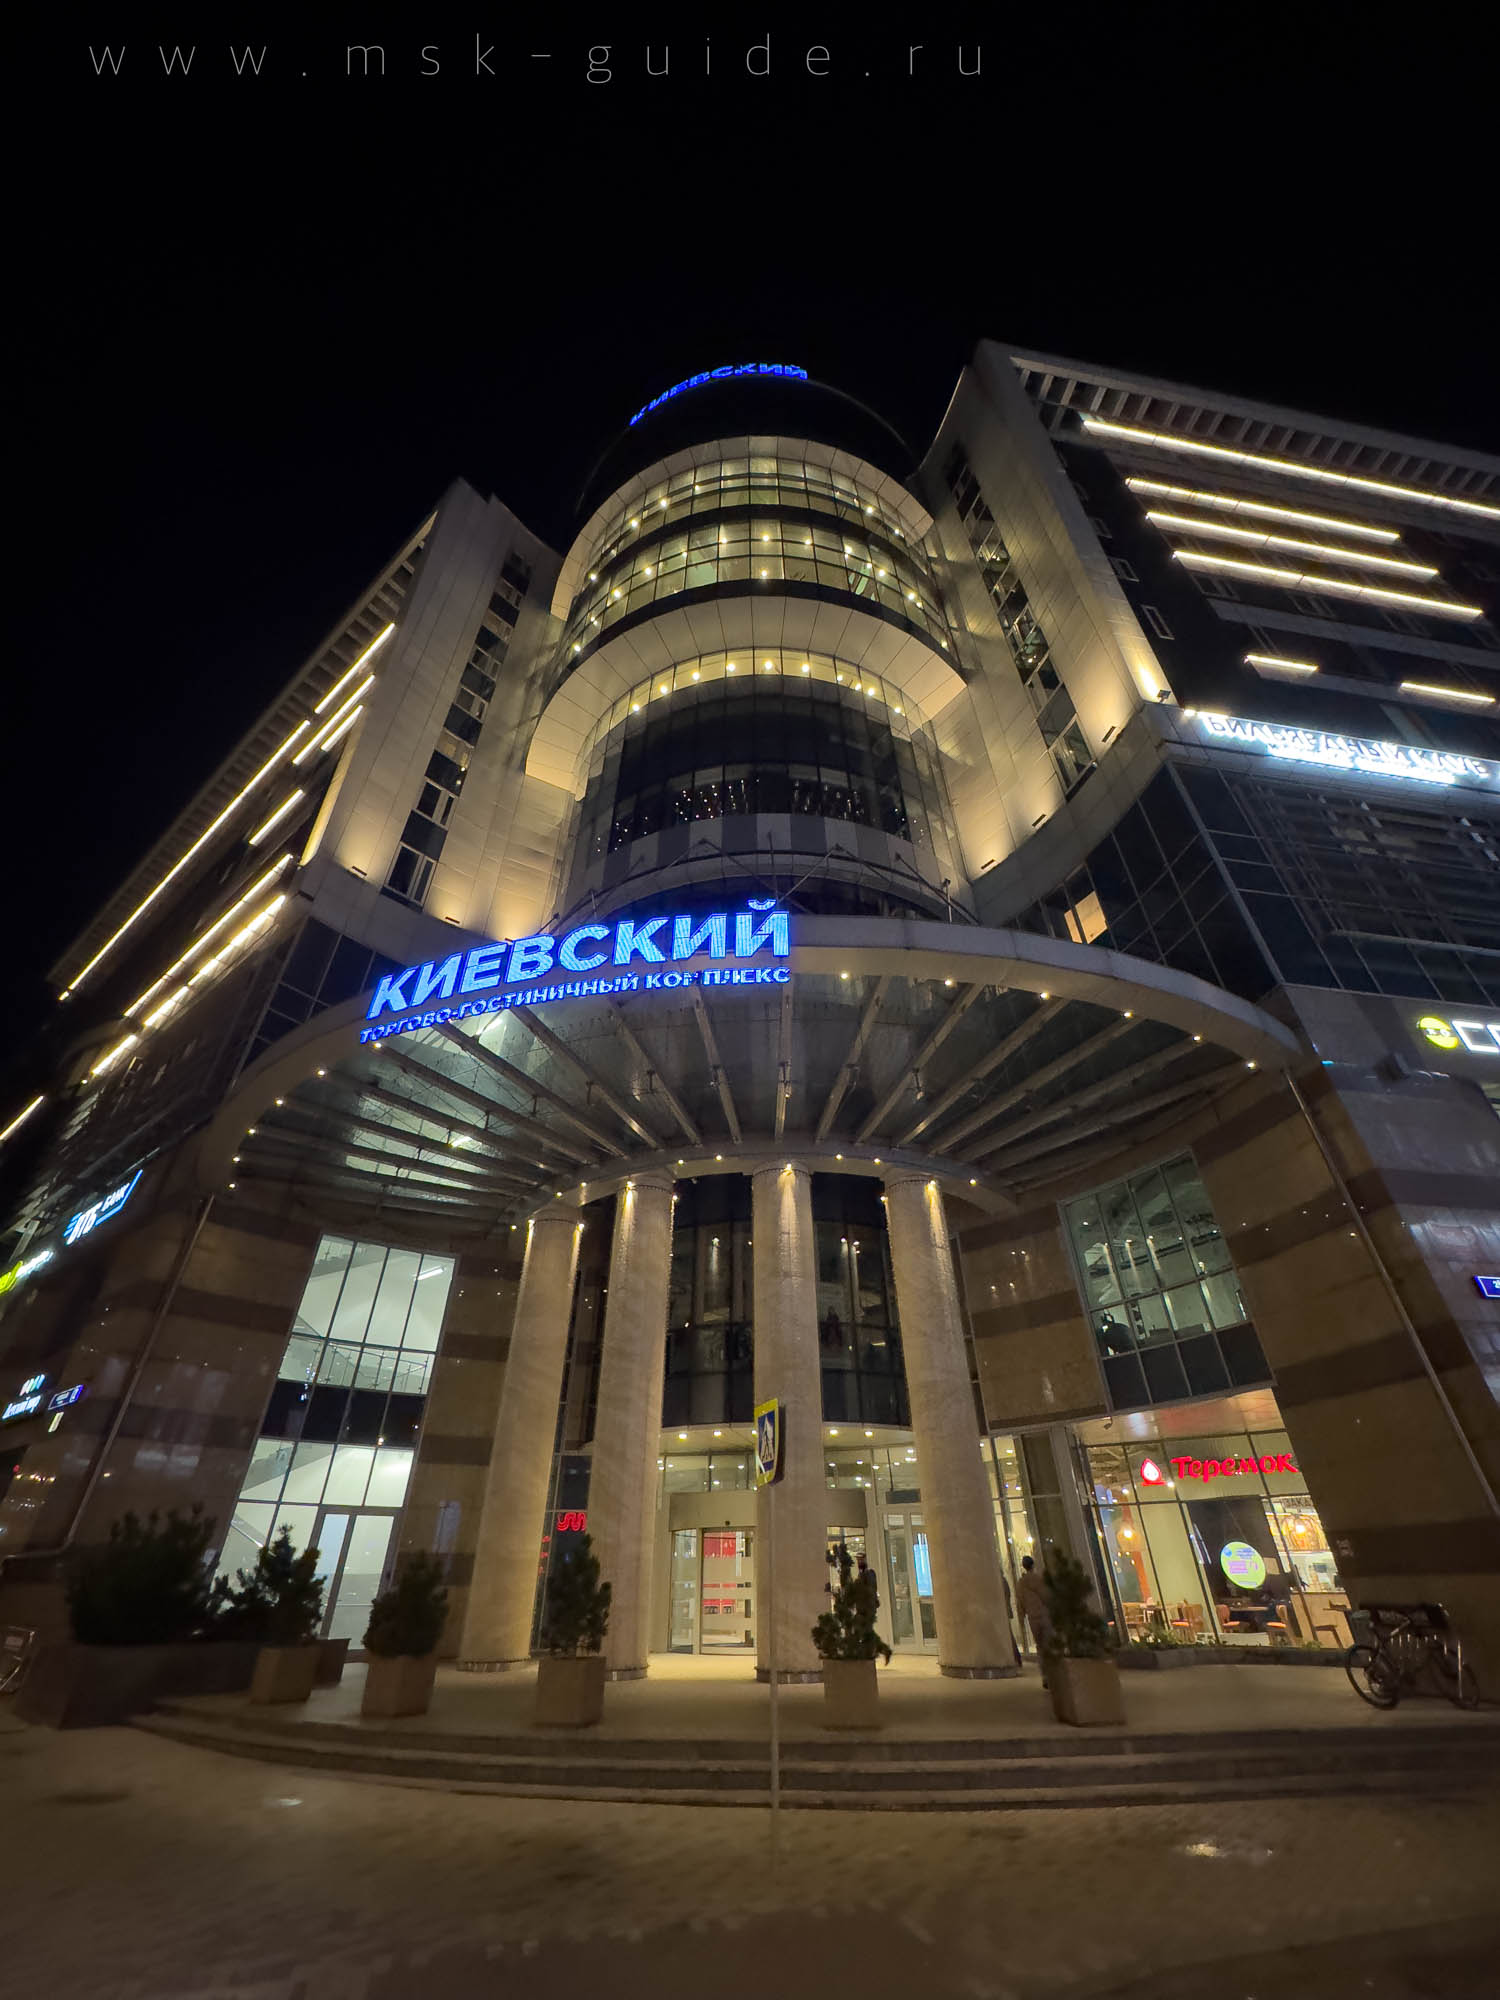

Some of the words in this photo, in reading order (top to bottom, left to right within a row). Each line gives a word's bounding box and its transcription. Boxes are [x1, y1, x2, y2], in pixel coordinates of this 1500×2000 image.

[366, 898, 791, 1020] КИЕВСКИЙ
[360, 970, 640, 1044] ТОРГОВО-ГОСТИНИЧНЫЙ
[1169, 1452, 1299, 1484] Теремок
